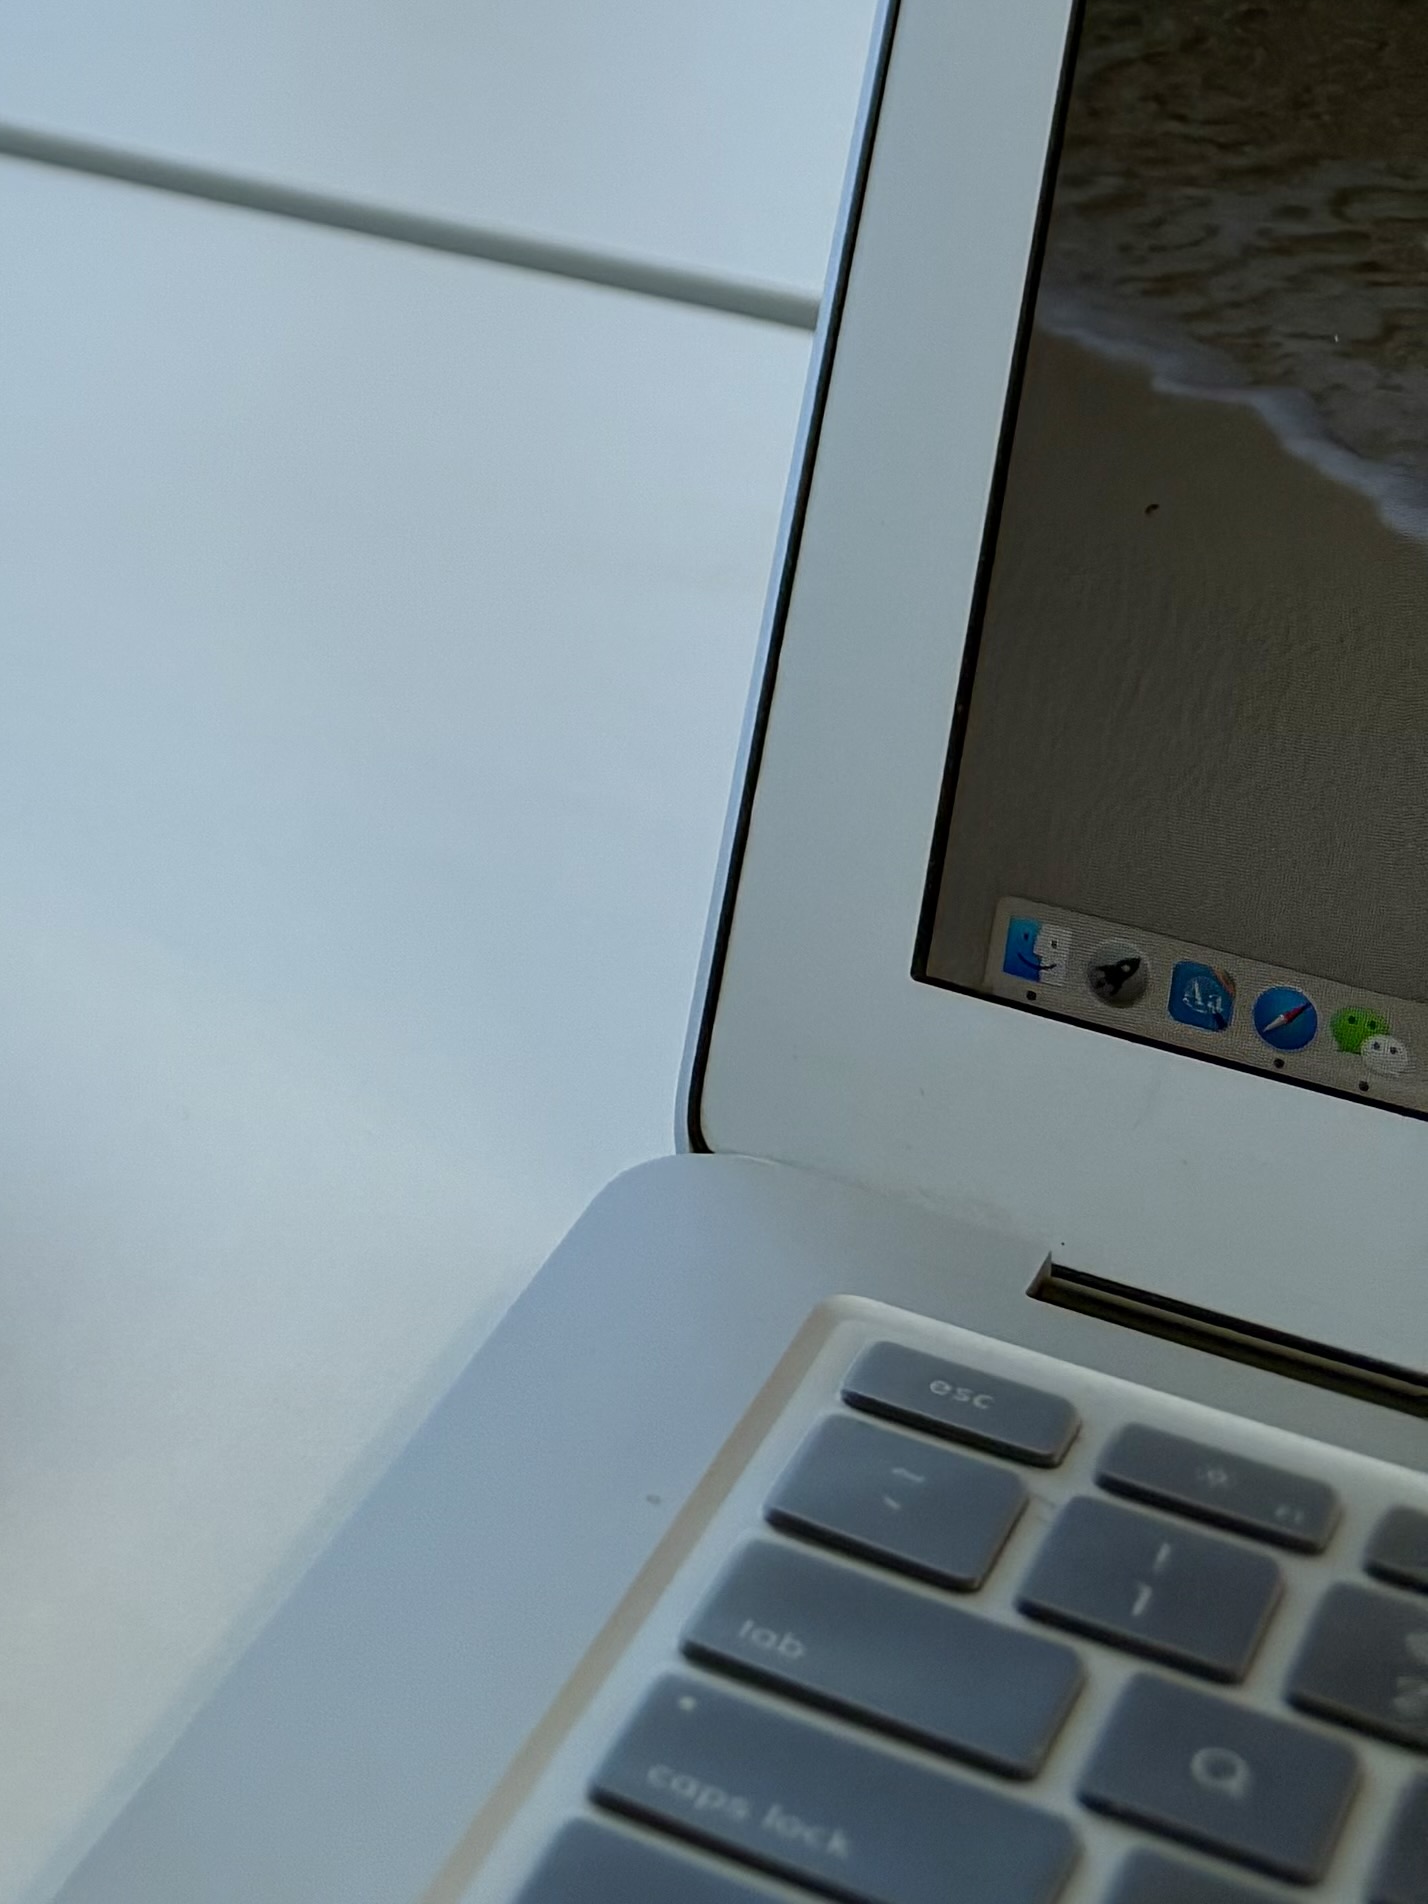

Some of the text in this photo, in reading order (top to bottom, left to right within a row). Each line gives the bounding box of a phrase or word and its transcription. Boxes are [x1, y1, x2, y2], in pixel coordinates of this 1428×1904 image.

[929, 1379, 994, 1410] esc
[738, 1618, 807, 1660] tab
[1190, 1746, 1252, 1801] Q
[646, 1763, 849, 1859] caps lock
